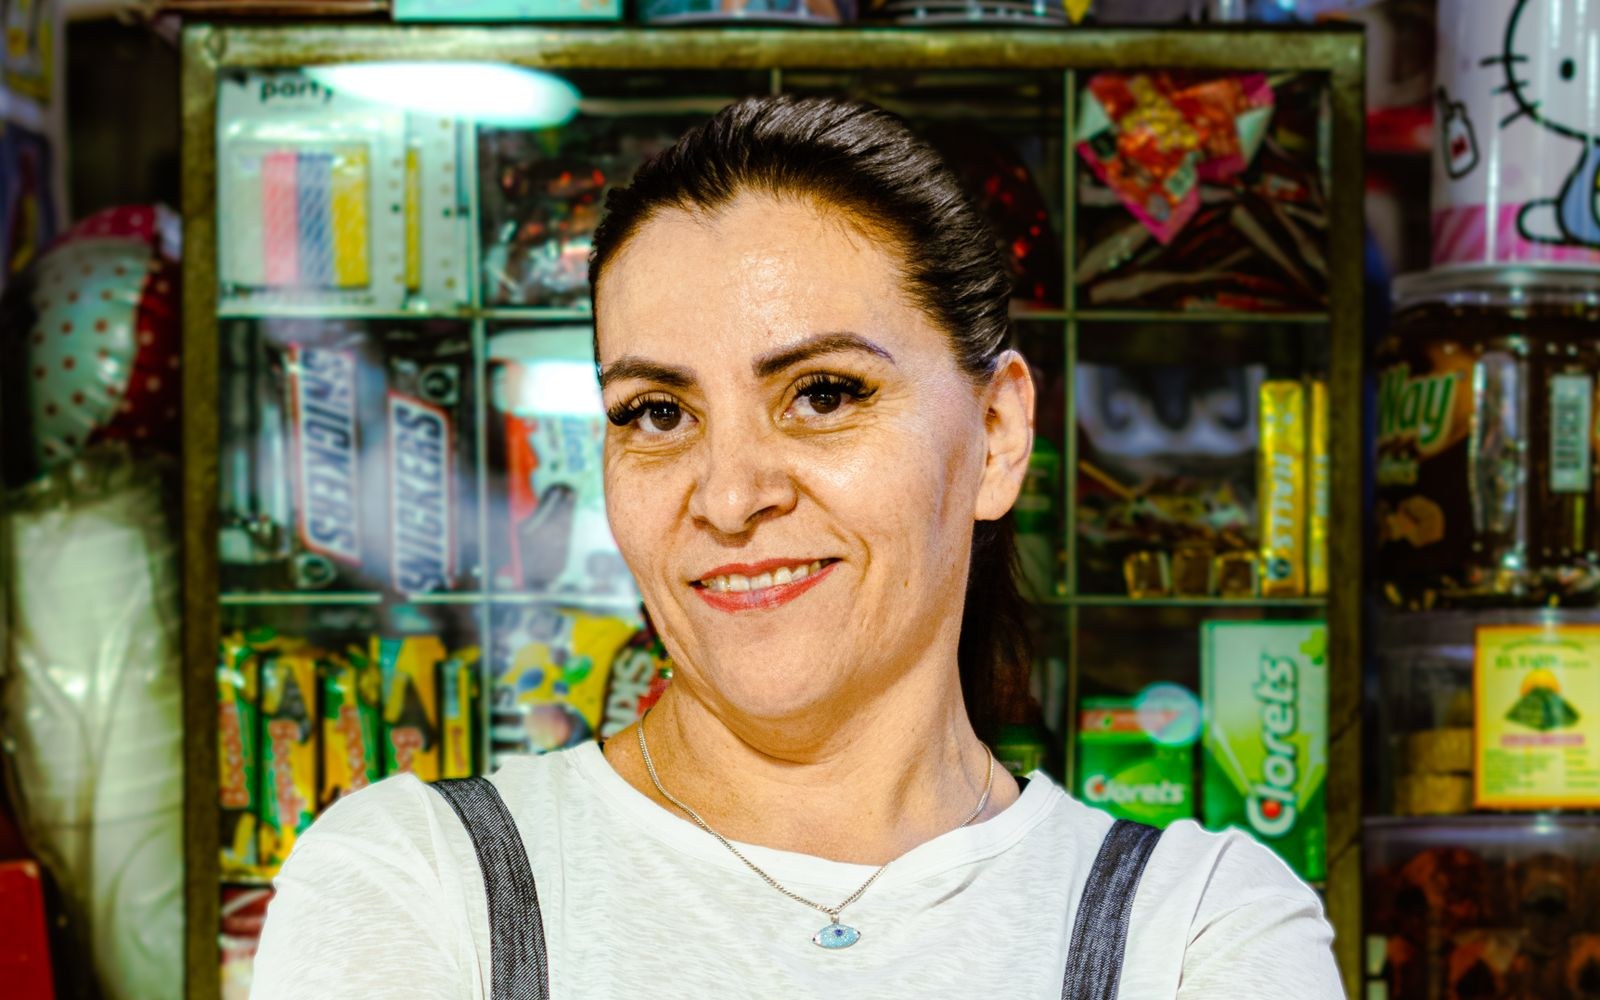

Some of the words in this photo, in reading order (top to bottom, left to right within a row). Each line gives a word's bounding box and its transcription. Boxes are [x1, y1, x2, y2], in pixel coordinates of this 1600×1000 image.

[302, 350, 351, 551] SNICKERS
[394, 405, 446, 591] SNICKERS
[1272, 453, 1294, 548] HALLS
[1084, 775, 1184, 804] Clorets
[1246, 654, 1297, 836] Clorets
